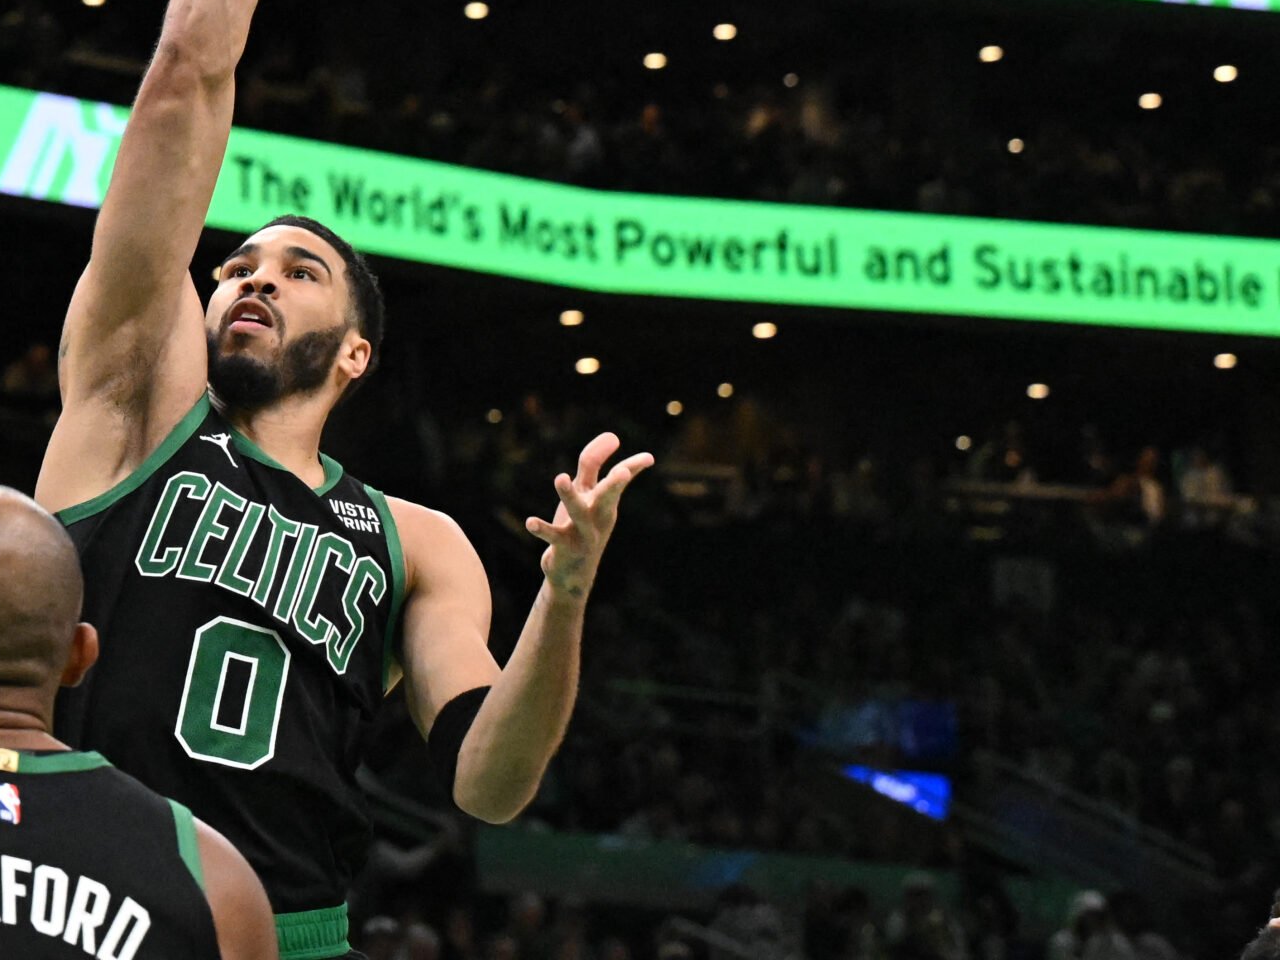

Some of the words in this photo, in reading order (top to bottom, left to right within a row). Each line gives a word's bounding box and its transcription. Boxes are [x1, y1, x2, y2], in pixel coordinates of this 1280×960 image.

[234, 155, 310, 211] The
[329, 171, 482, 242] World's
[500, 204, 598, 260] Most
[615, 218, 837, 277] Powerful
[865, 246, 951, 286] and
[975, 246, 1263, 309] Sustainable
[135, 470, 387, 675] CELTICS
[328, 498, 380, 522] VISTA
[337, 514, 381, 534] RINT
[174, 615, 291, 770] 0
